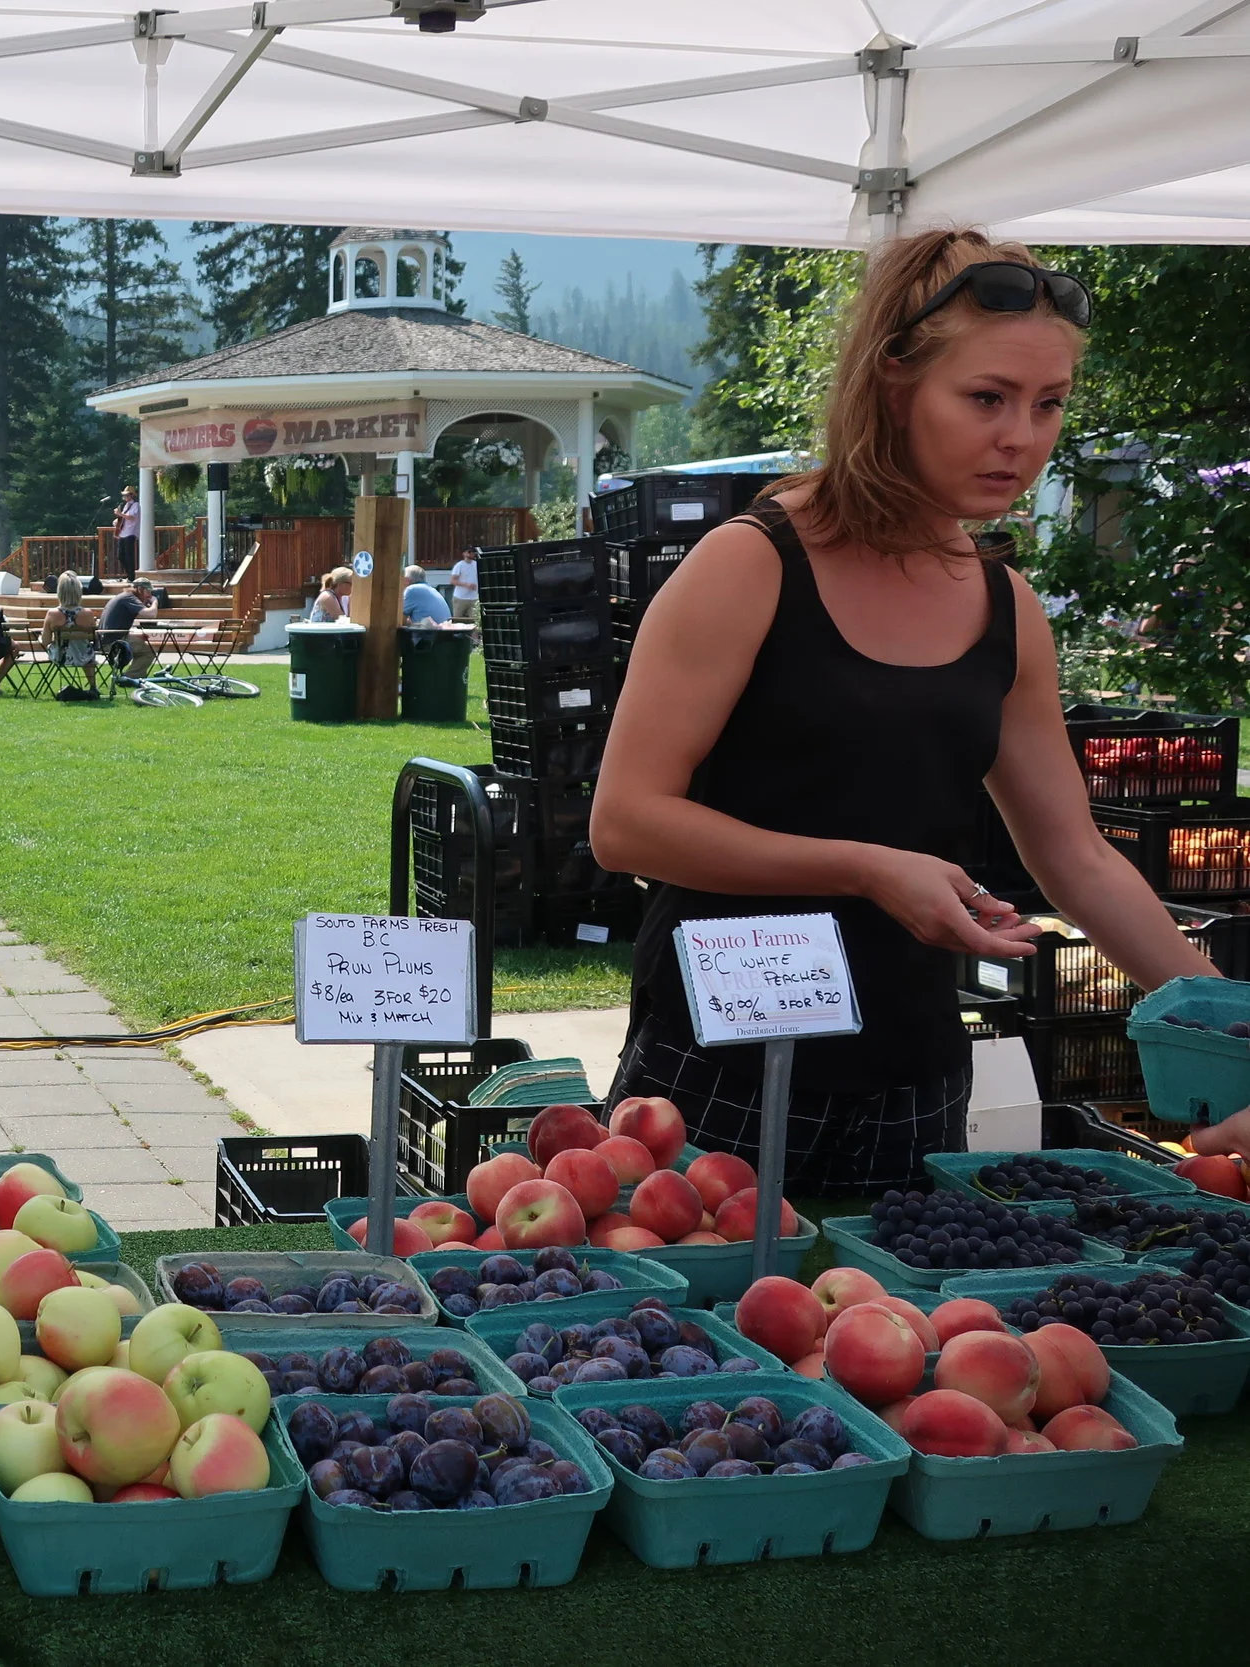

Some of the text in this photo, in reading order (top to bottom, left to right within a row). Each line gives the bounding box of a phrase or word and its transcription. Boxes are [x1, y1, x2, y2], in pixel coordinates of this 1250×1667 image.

[164, 413, 420, 453] FARMERS MARKET
[316, 917, 458, 934] SOUTO FARMS FRESH
[692, 929, 809, 950] Souto Farms
[328, 952, 433, 975] PRUN PLUMS
[740, 953, 792, 969] WHITE
[763, 968, 831, 986] PEACHES
[419, 984, 451, 1004] $20
[815, 989, 842, 1004] $20
[384, 1011, 433, 1025] MATCH
[736, 1025, 800, 1036] Distributed from:
